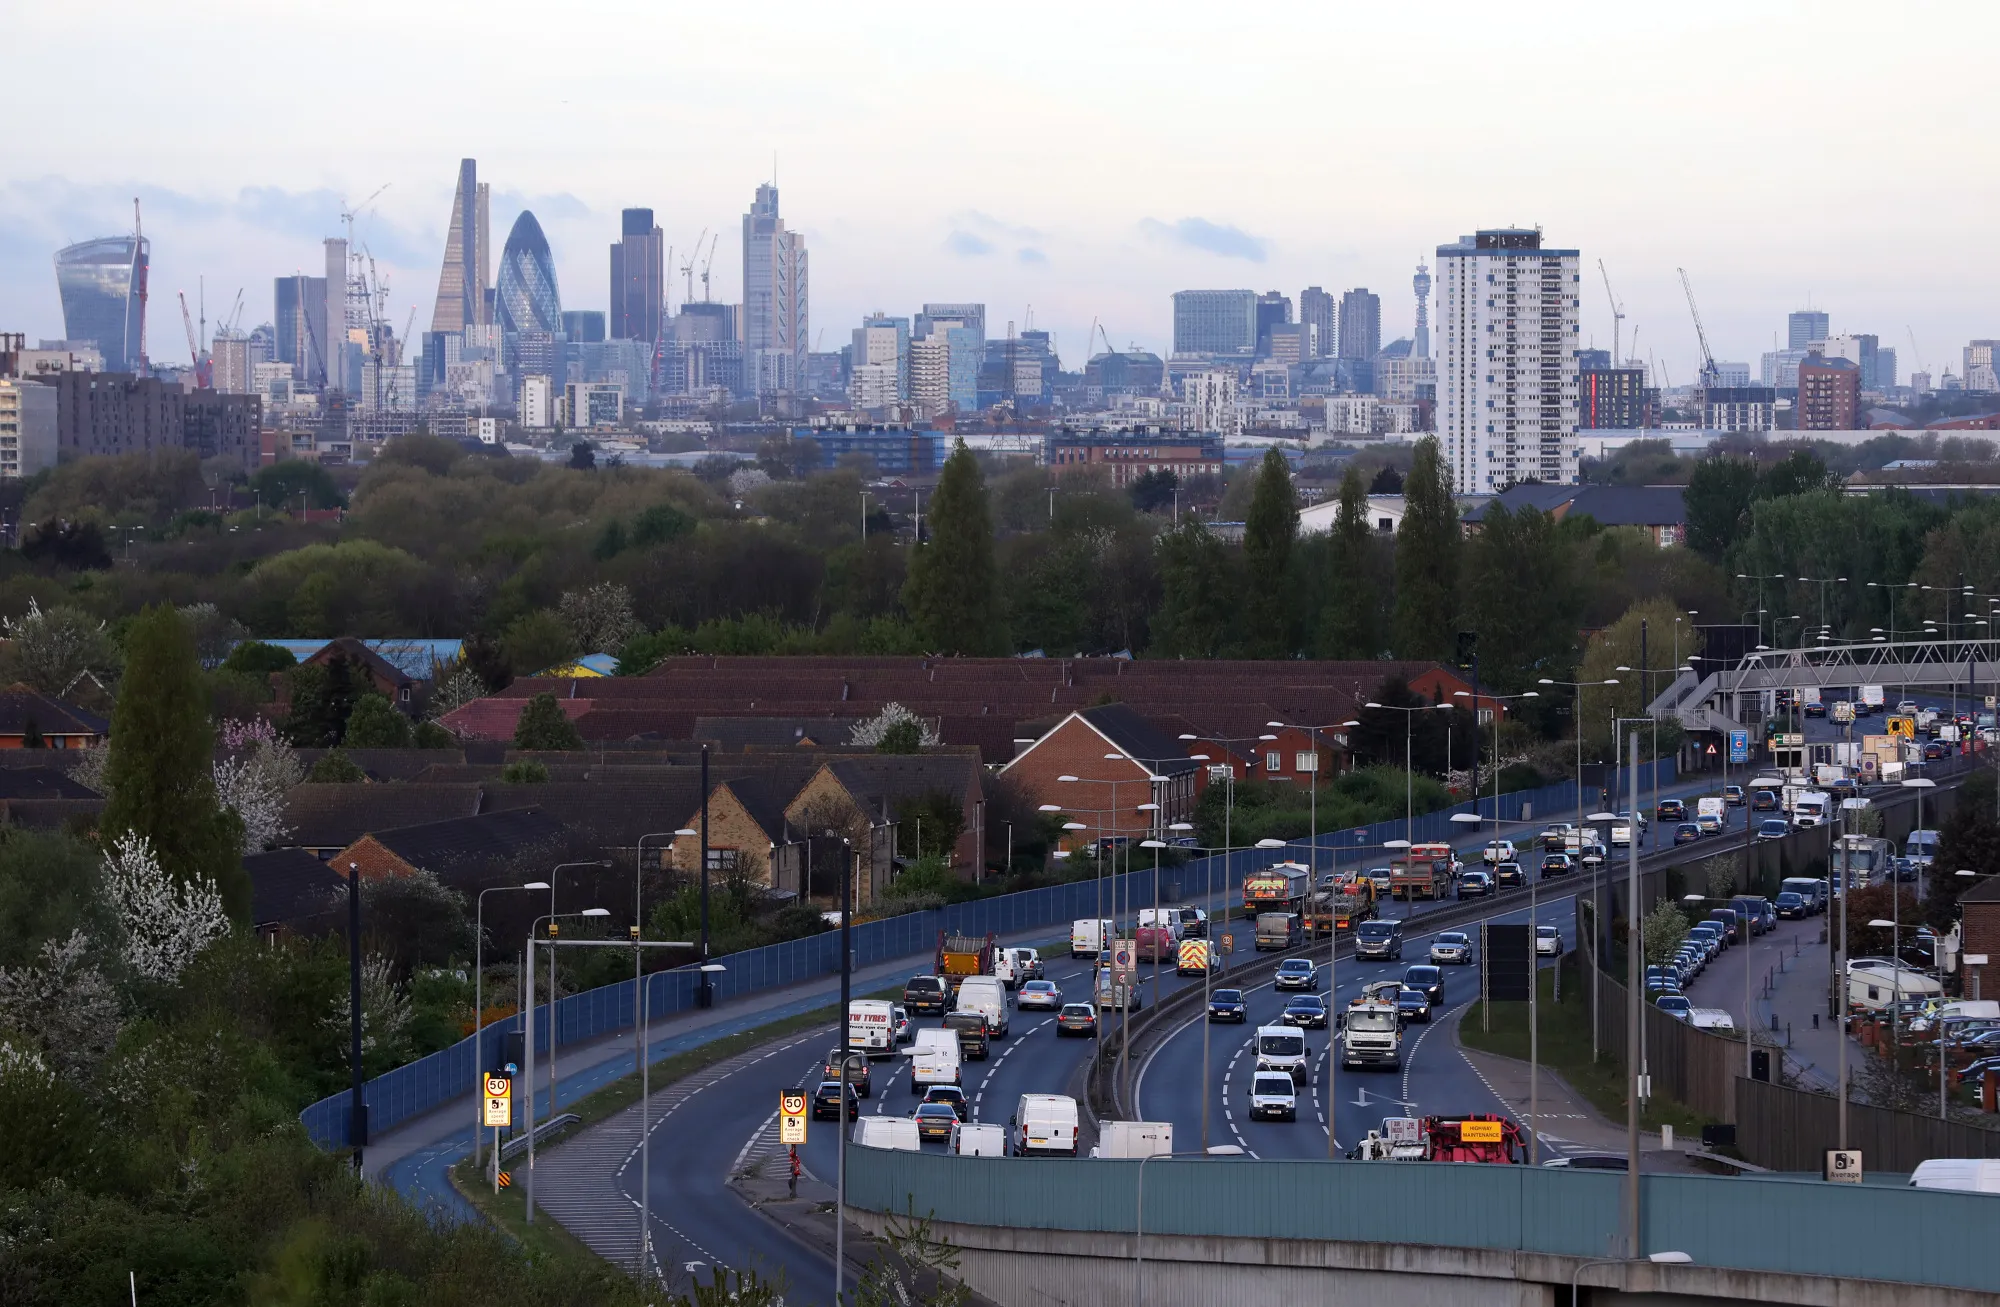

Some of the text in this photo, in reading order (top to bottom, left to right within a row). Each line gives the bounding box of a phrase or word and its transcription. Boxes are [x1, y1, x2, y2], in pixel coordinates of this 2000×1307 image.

[863, 1014, 887, 1023] TYRES
[489, 1080, 505, 1090] 50
[786, 1098, 802, 1108] 50
[1830, 1171, 1860, 1179] Average
